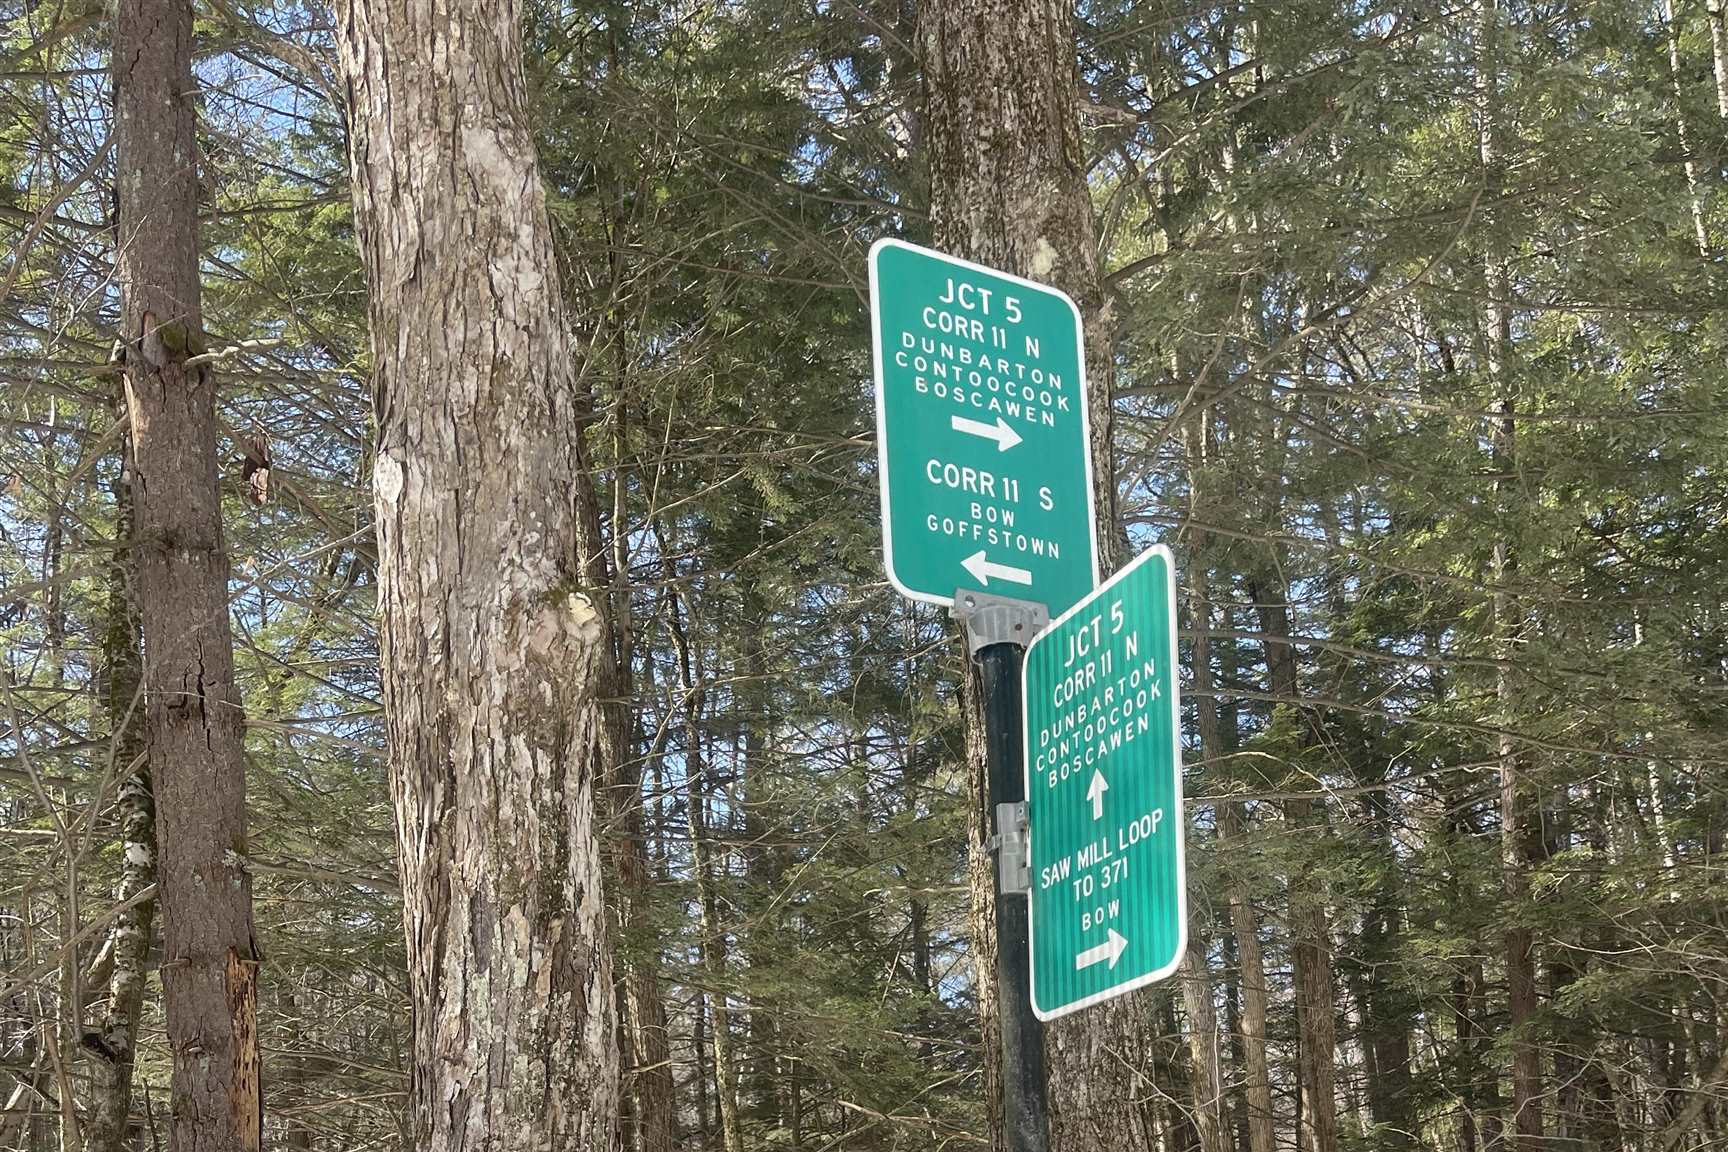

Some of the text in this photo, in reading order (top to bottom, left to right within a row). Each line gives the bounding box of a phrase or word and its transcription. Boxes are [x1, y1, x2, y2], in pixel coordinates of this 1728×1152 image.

[939, 278, 1023, 324] JCT 5
[902, 331, 1062, 390] DUNBARTON
[922, 307, 1040, 359] CORR 11 N
[896, 351, 1070, 412] CONTOOCOOK
[915, 376, 1054, 427] BOSCAWEN
[926, 459, 1054, 511] CORR 11 S
[927, 514, 1059, 560] GOFFSTOWN
[971, 502, 1015, 528] BOW
[1064, 599, 1124, 668] JCT 5
[1053, 630, 1138, 708] CORR 11 N
[1036, 678, 1161, 772] CONTOOCOOK
[1041, 658, 1155, 747] DUNBARTON
[1049, 712, 1149, 788] BOSCAWEN
[1041, 807, 1163, 889] SAW MILL LOOP
[1073, 856, 1129, 902] TO 371
[1082, 899, 1120, 932] BOW
